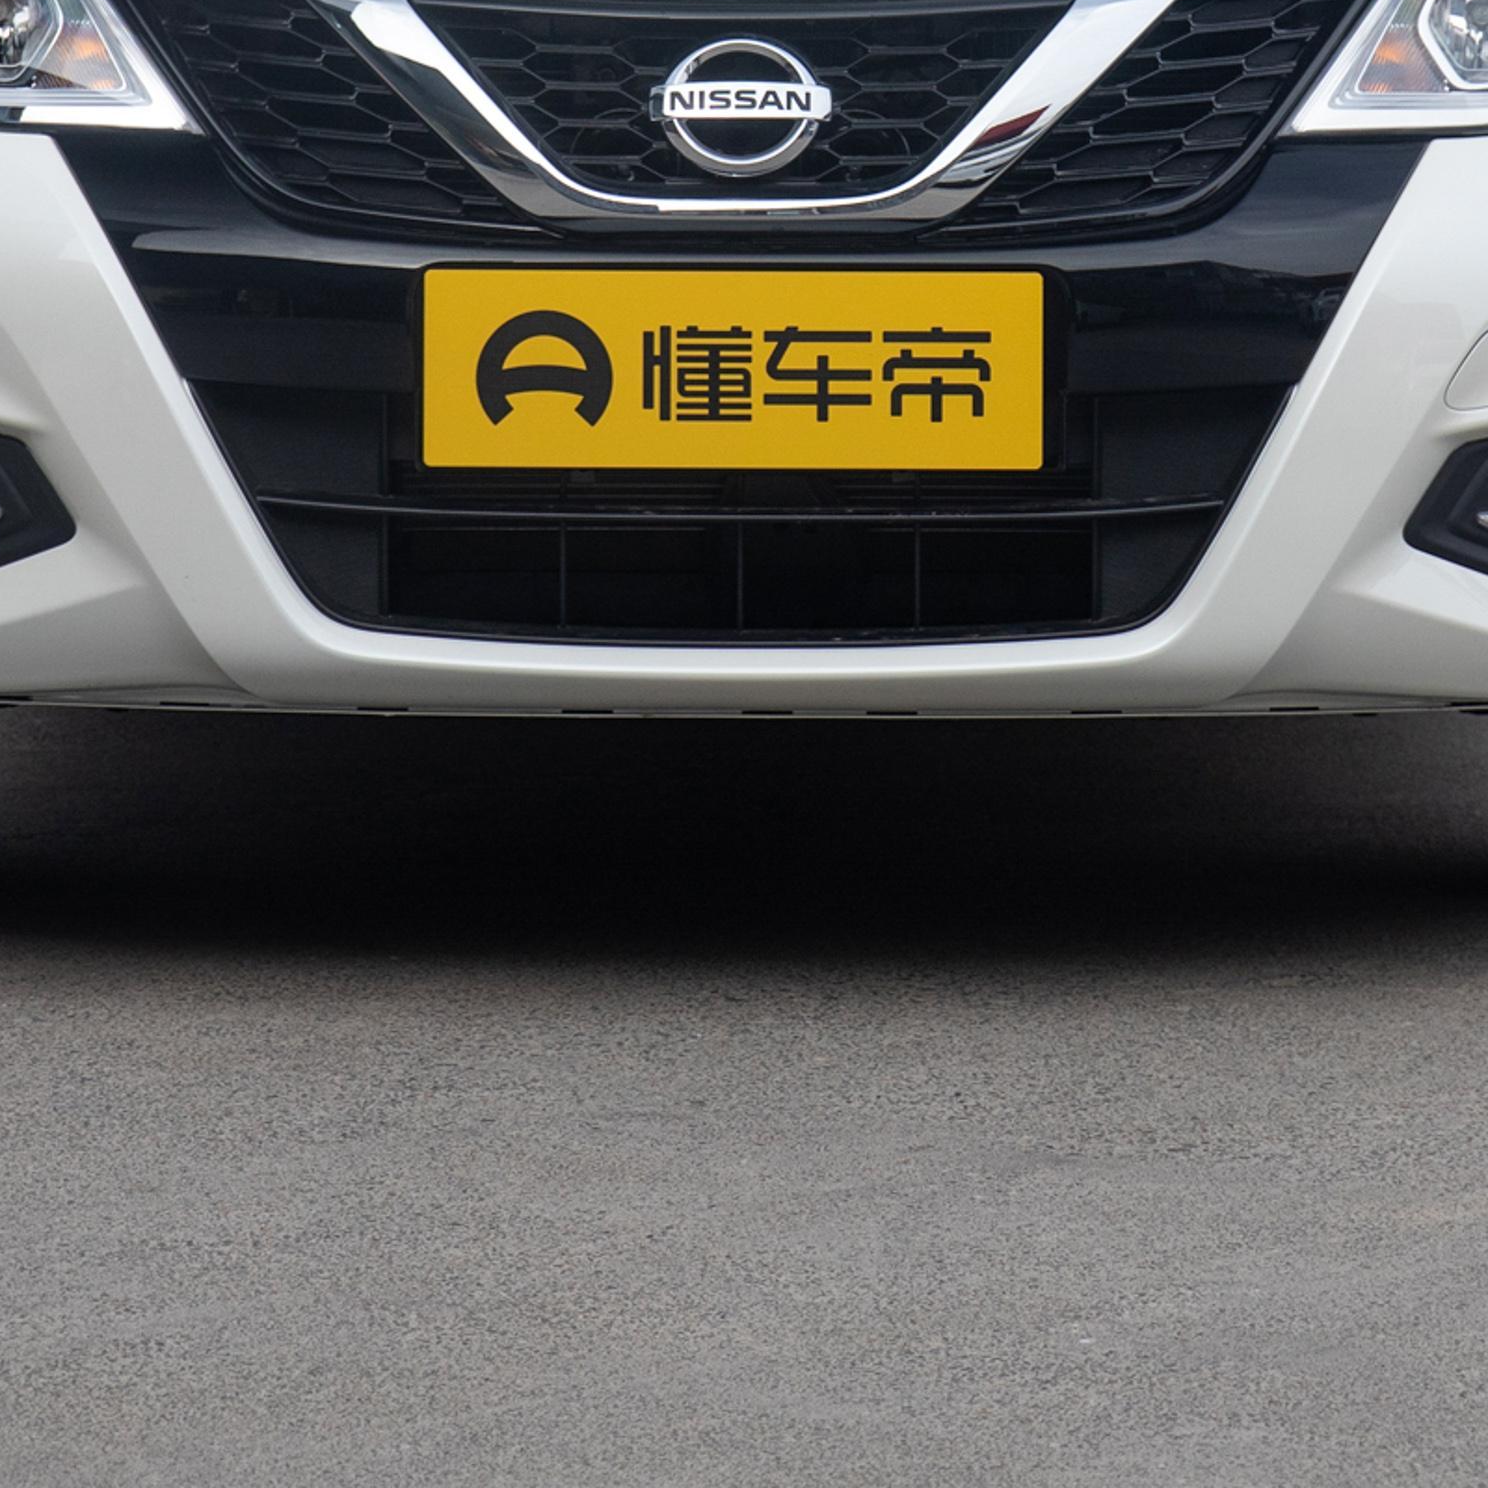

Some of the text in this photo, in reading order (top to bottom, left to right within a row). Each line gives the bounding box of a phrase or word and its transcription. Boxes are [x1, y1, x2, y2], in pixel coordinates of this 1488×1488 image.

[669, 89, 813, 112] NISSAN
[642, 324, 992, 423] 懂车帝
